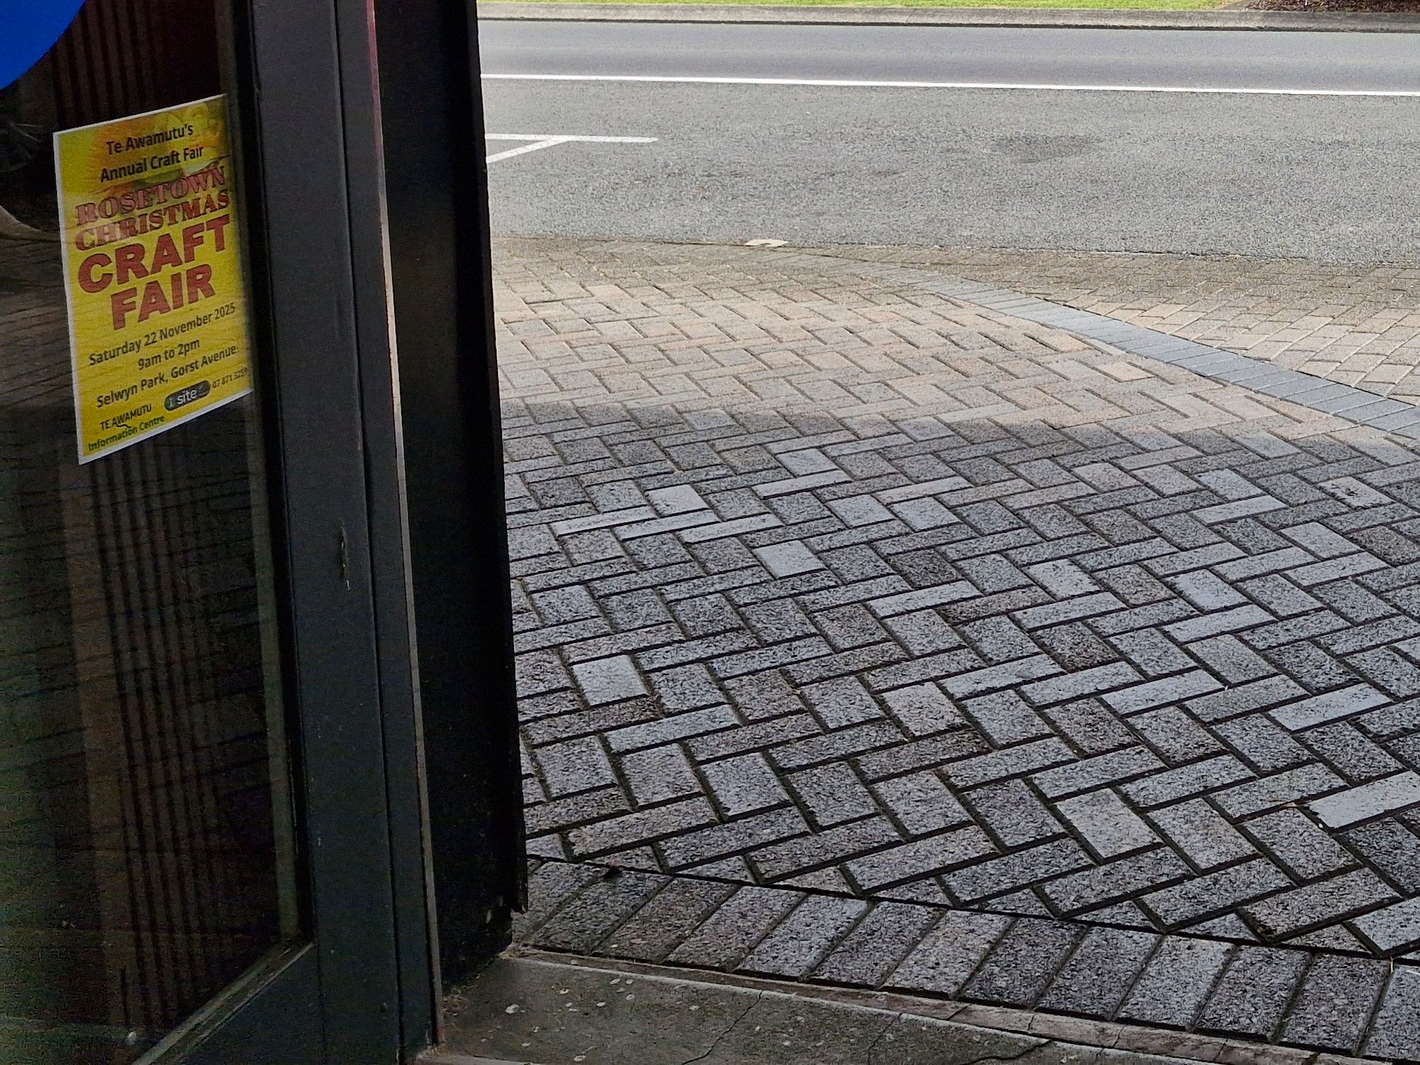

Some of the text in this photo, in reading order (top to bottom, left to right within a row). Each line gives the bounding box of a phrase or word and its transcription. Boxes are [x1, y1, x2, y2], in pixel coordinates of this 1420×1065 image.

[106, 124, 194, 155] Te Awamutu's
[101, 145, 203, 182] Annual Craft Fair
[76, 166, 226, 226] ROSETOWN
[76, 189, 230, 251] CHRISTMAS
[78, 214, 230, 294] CRAFT
[110, 264, 216, 330] FAIR
[89, 302, 235, 366] Saturday 22 November 2025
[138, 339, 200, 370] 9am to 2pm
[97, 346, 236, 408] Selwyn Park, Gorst Avenue
[212, 379, 221, 388] 07
[177, 388, 198, 404] site
[88, 414, 165, 451] Information Centre
[100, 403, 152, 431] TE AWAMUTU
